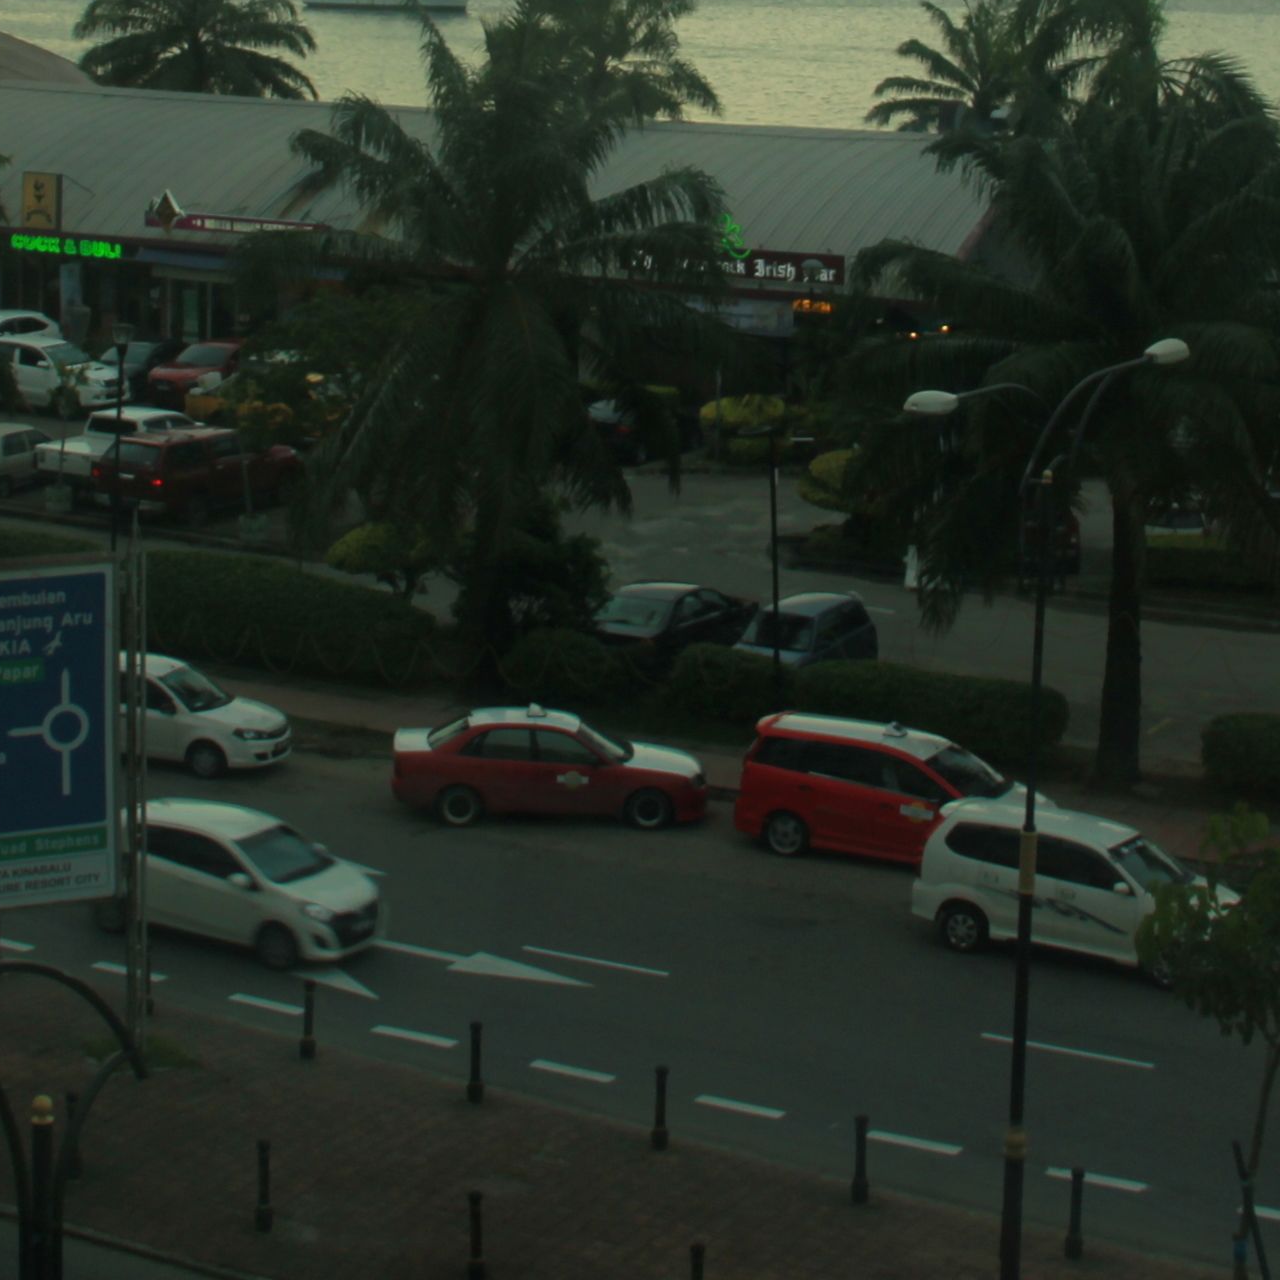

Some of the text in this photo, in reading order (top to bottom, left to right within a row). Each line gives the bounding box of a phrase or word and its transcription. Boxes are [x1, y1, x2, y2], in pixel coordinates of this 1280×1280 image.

[754, 259, 796, 281] Irish
[61, 611, 94, 627] Aru
[35, 832, 100, 853] Stephens
[11, 863, 71, 879] KINABALU
[23, 875, 72, 893] RESORT
[74, 872, 100, 886] CITY
